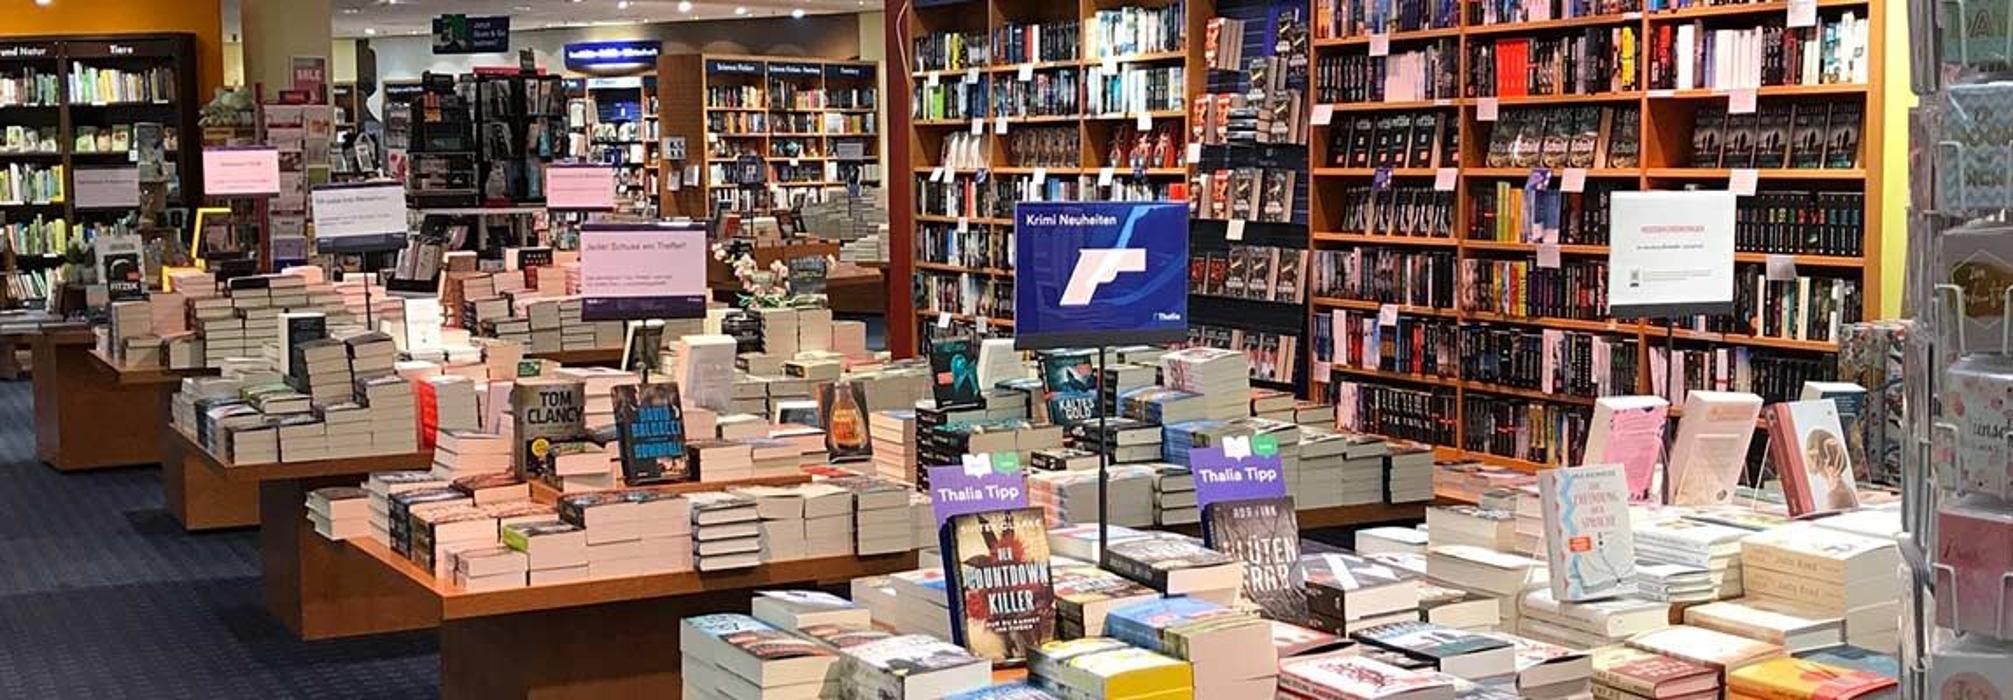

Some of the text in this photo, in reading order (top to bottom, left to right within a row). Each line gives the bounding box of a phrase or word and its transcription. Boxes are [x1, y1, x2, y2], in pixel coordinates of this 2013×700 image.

[109, 44, 134, 55] Tiere
[1026, 214, 1117, 226] Krimi Neuheiten
[1158, 313, 1181, 321] Thalia
[540, 391, 573, 406] TOM
[1059, 397, 1095, 410] KALTES
[527, 405, 584, 424] CLANCY
[1199, 467, 1277, 483] Thalia Tipp
[938, 485, 1019, 502] Thalia Tipp
[963, 561, 1049, 589] COUNTDOWN
[988, 590, 1035, 615] KILLER
